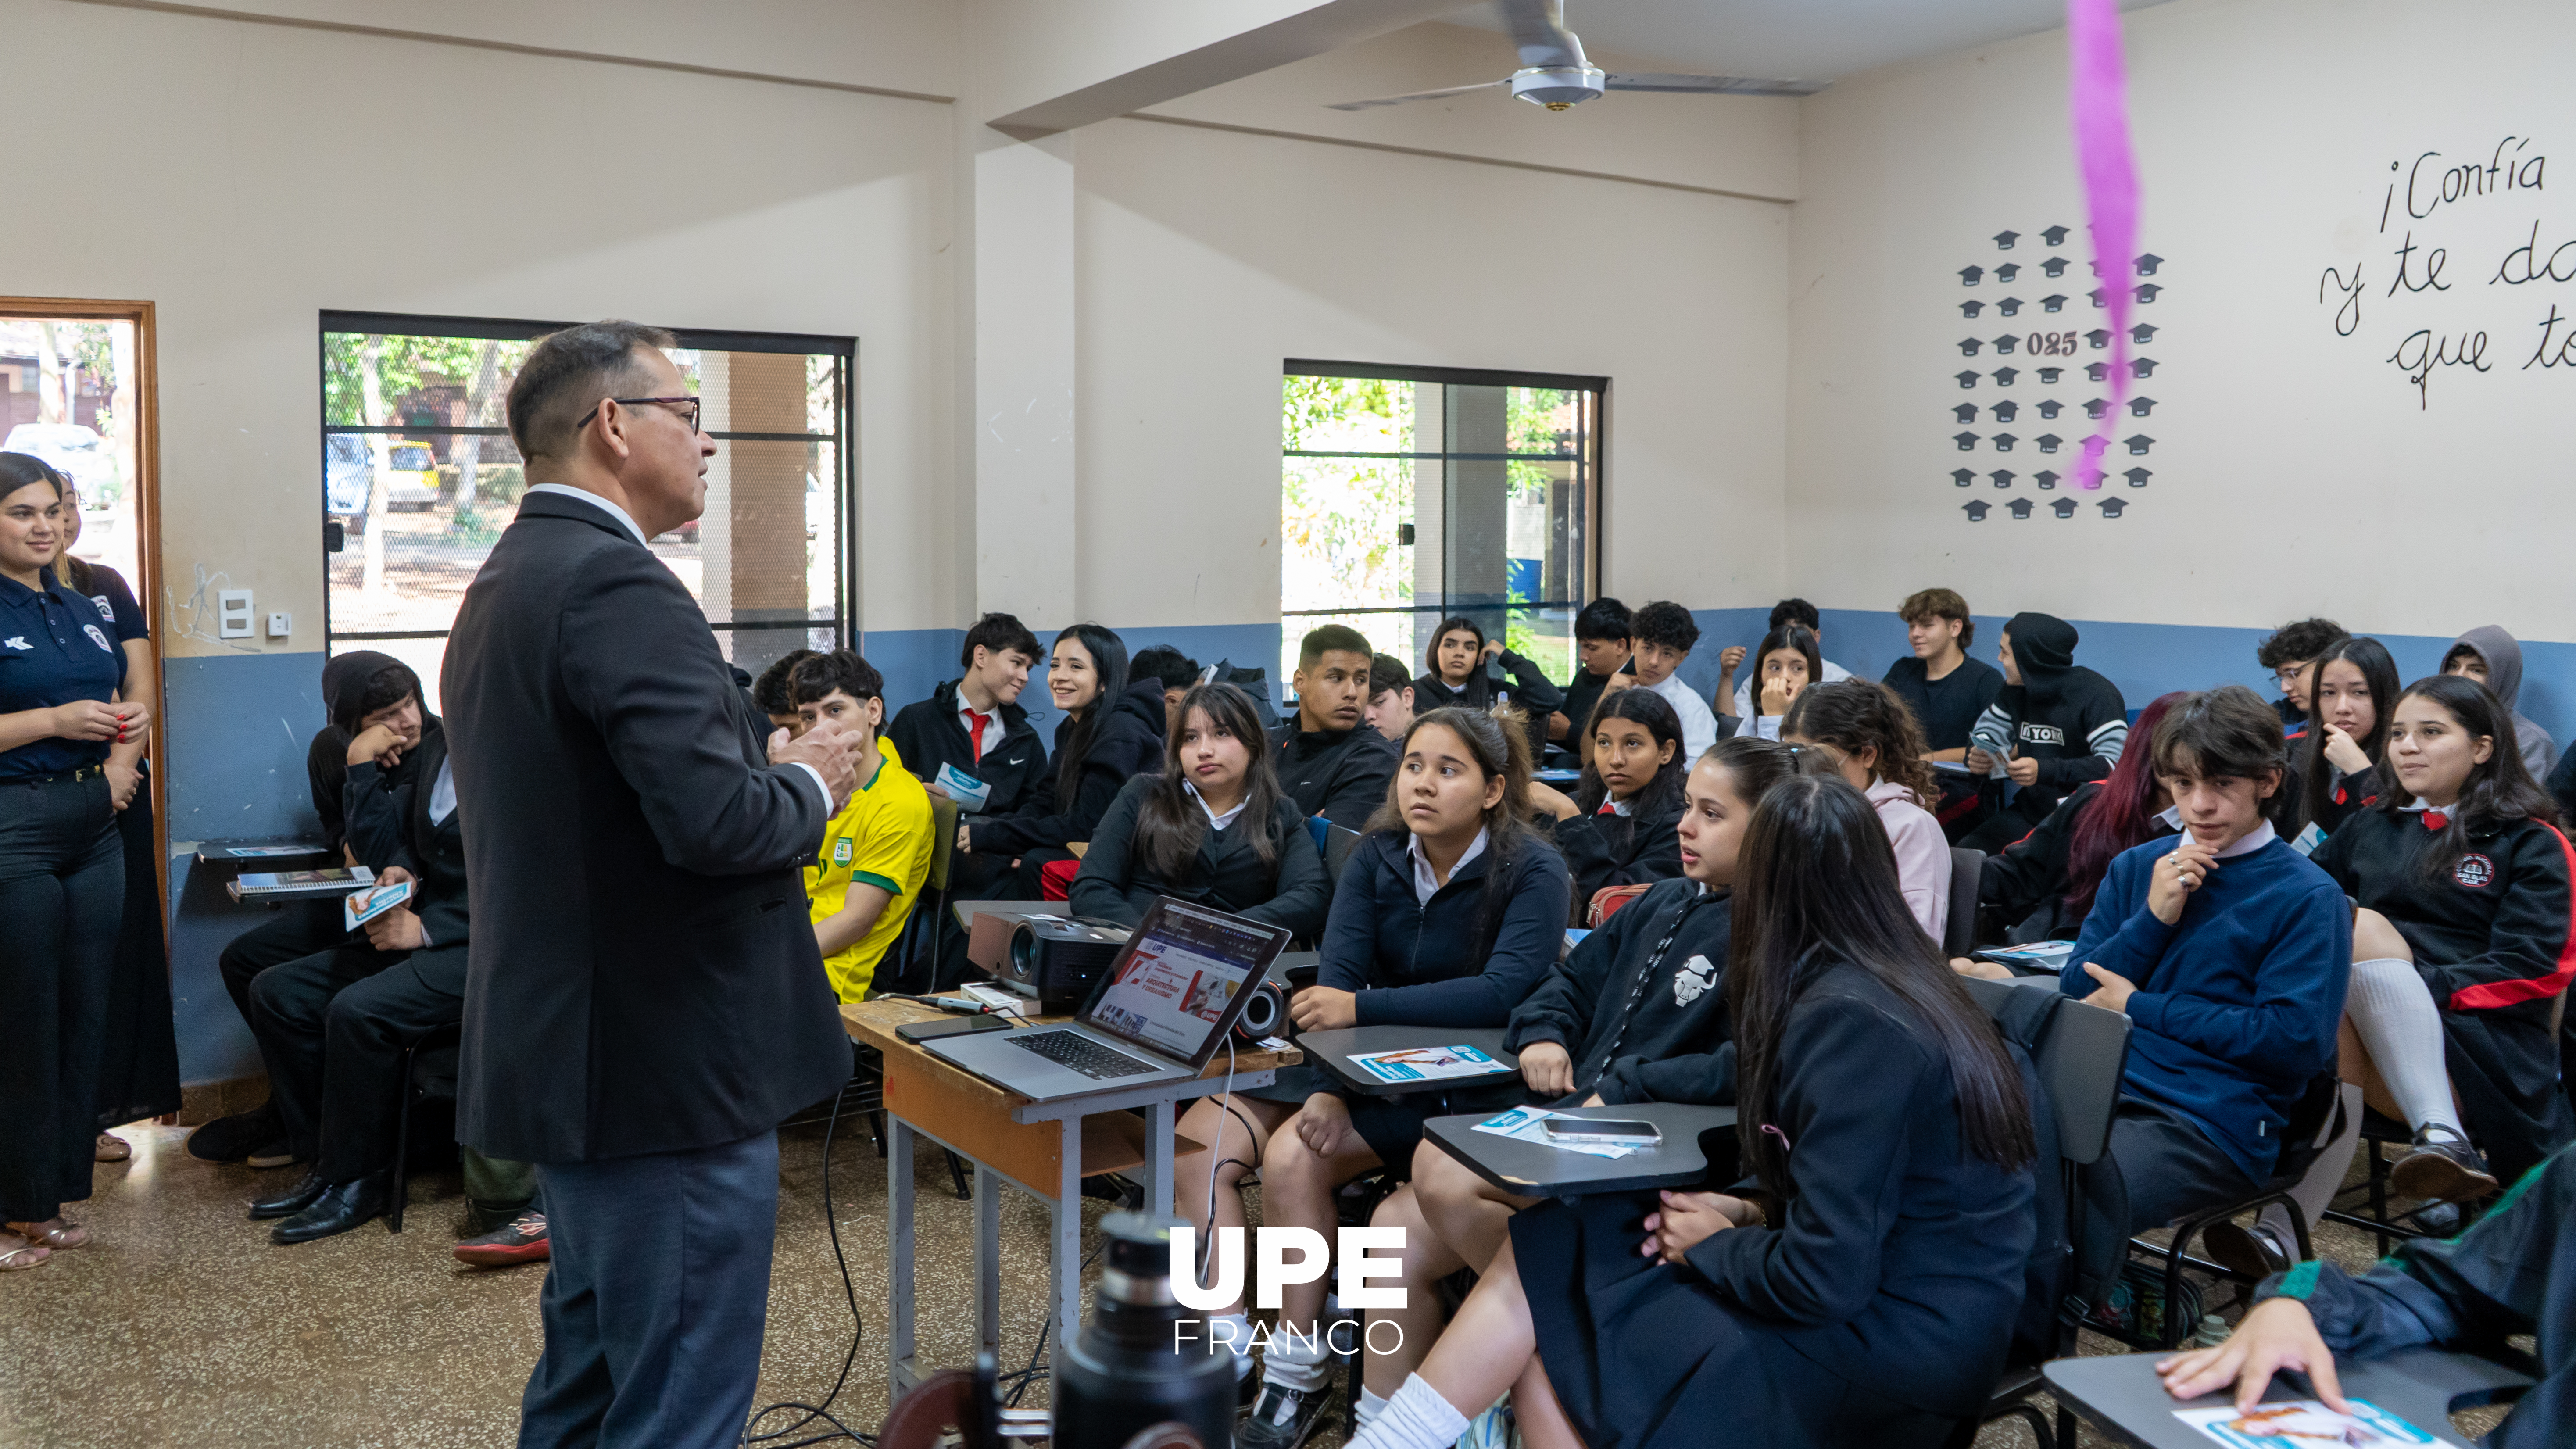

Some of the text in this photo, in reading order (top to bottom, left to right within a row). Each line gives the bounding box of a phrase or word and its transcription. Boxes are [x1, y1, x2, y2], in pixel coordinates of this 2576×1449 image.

[2380, 136, 2546, 233] ¡Confía
[2319, 262, 2365, 336] y
[2387, 230, 2452, 298] te
[2026, 330, 2078, 357] 025
[2386, 329, 2493, 411] que
[1152, 944, 1167, 954] UPE
[1145, 977, 1180, 994] ARQUITECTURA
[1145, 985, 1172, 999] URBANISMO
[1206, 1013, 1218, 1021] UPE
